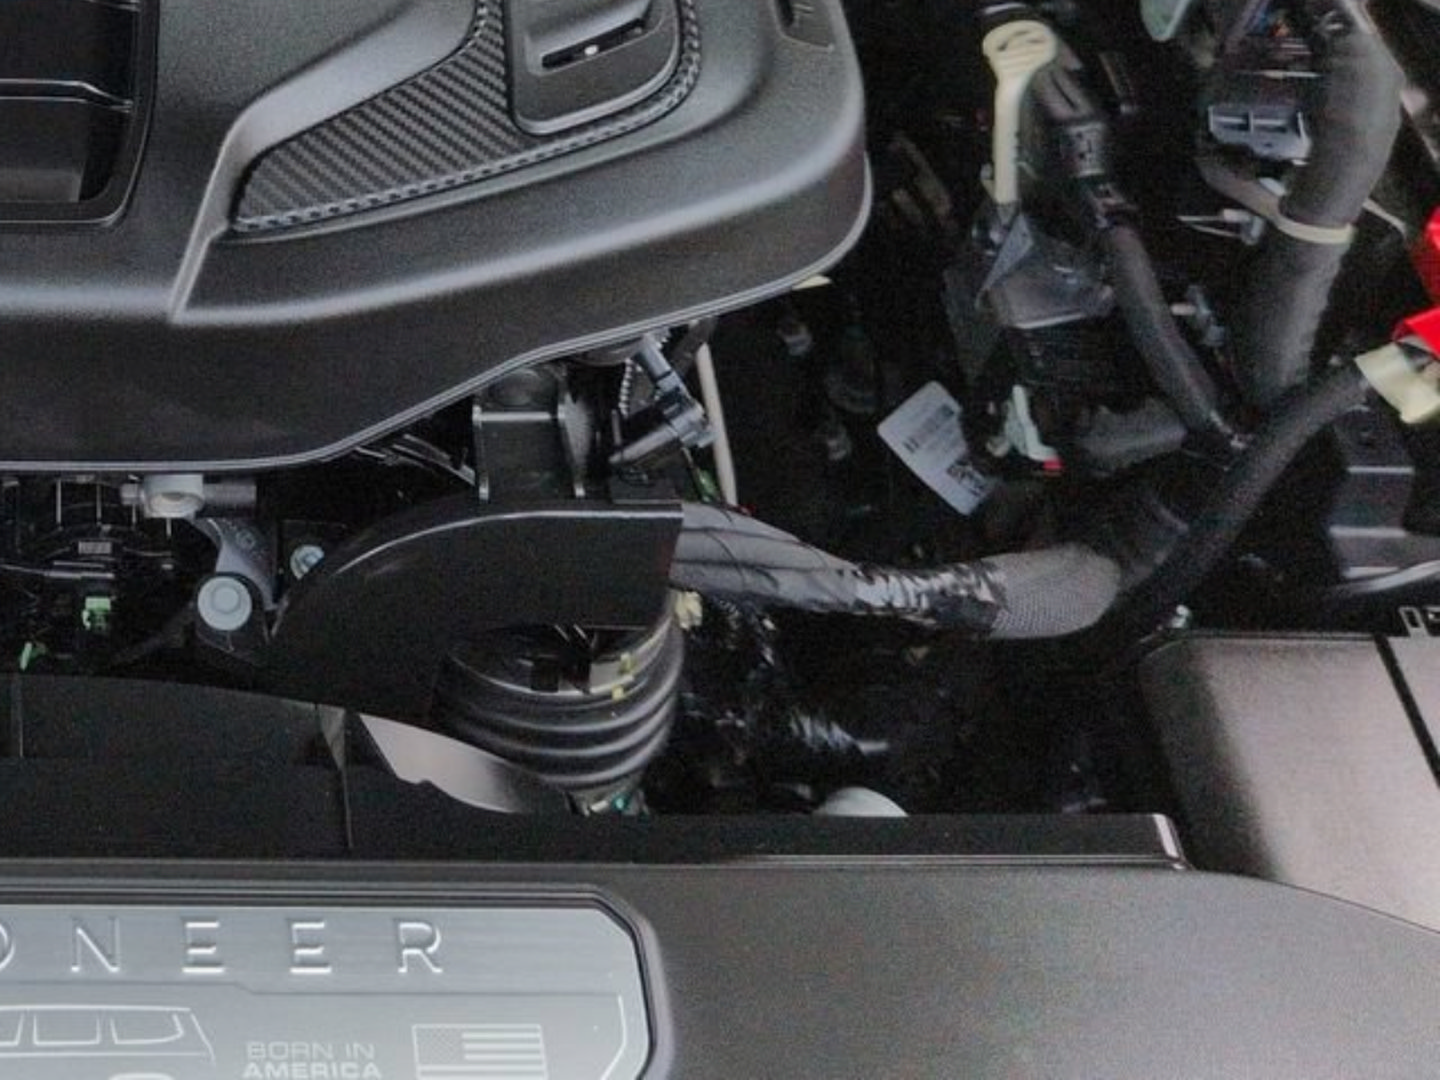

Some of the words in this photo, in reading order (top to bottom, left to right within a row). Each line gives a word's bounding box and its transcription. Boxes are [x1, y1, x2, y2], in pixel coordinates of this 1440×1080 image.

[247, 1041, 334, 1061] BORN
[345, 1041, 377, 1061] IN
[242, 1060, 383, 1080] AMERICA
